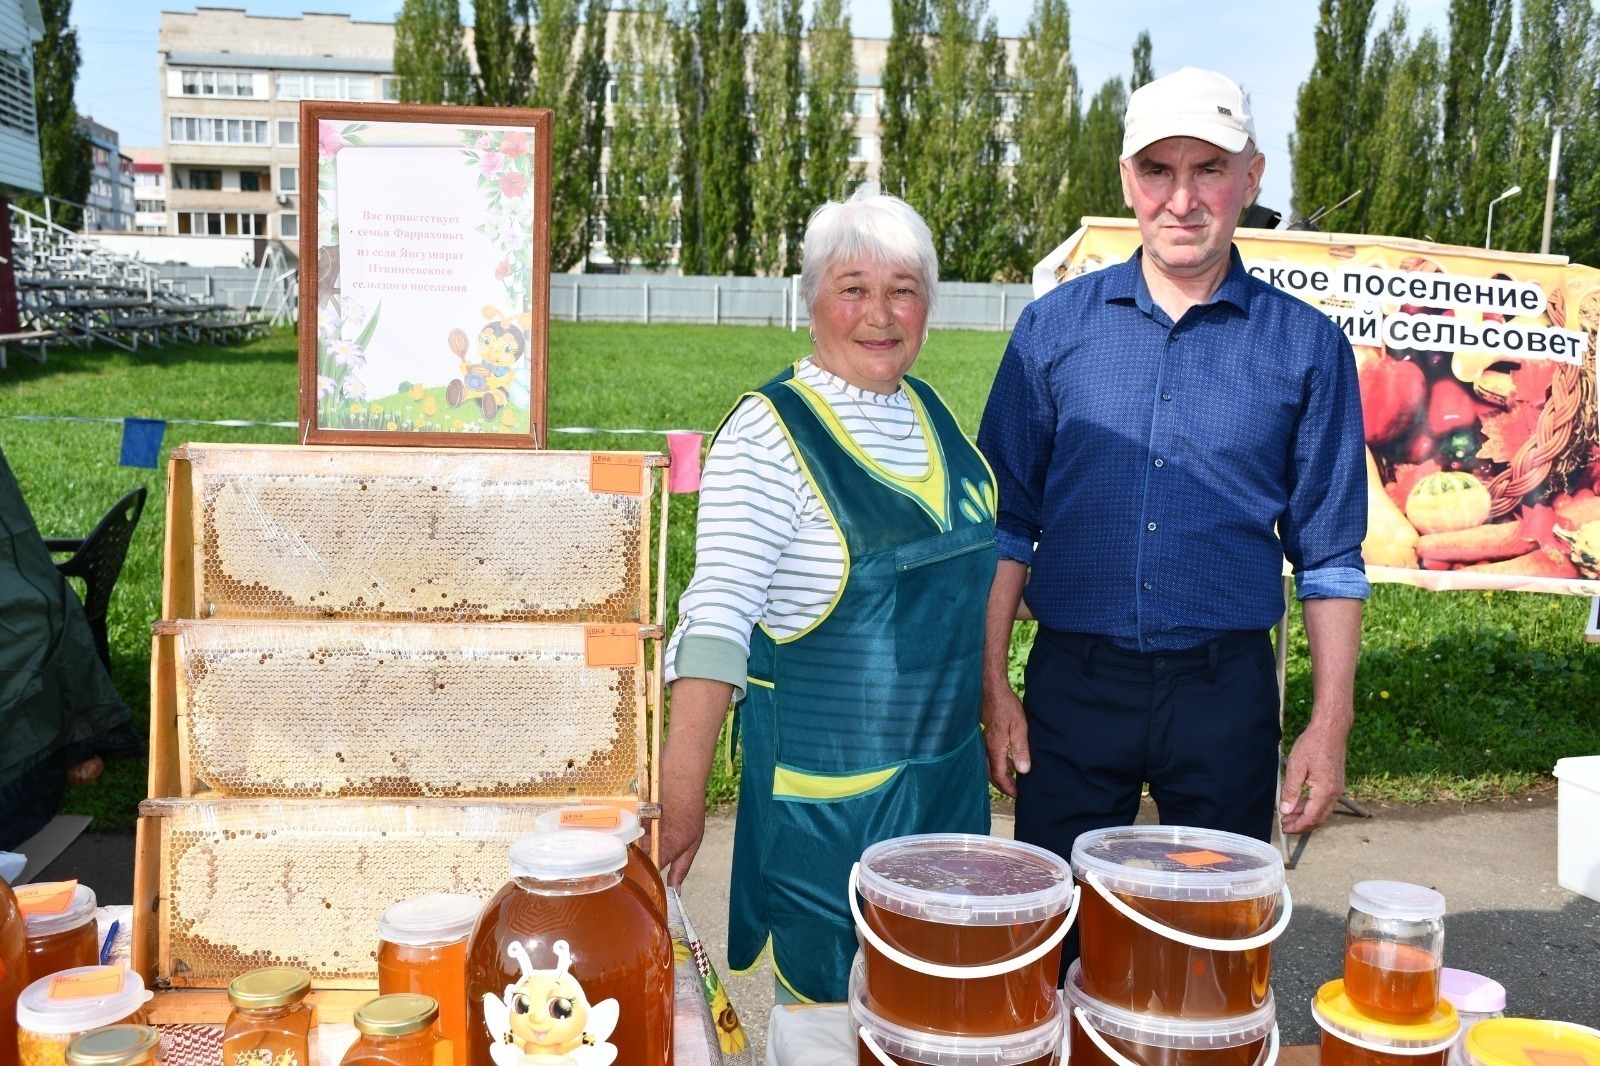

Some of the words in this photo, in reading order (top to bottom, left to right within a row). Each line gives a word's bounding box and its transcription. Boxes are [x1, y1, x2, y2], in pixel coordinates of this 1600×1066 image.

[363, 210, 382, 220] Вас
[385, 213, 460, 225] приветствует
[357, 229, 390, 238] семья
[394, 228, 464, 241] Фарраховых
[357, 249, 370, 257] из
[372, 249, 396, 258] села
[368, 263, 453, 276] Иткинеевского
[352, 281, 408, 291] сельского
[410, 282, 467, 293] поселения
[1343, 273, 1539, 310] поселение
[1389, 319, 1581, 358] сельсовет
[592, 455, 611, 463] ЦЕНА
[586, 628, 605, 636] ЦЕНА
[17, 890, 39, 898] ЦЕНА
